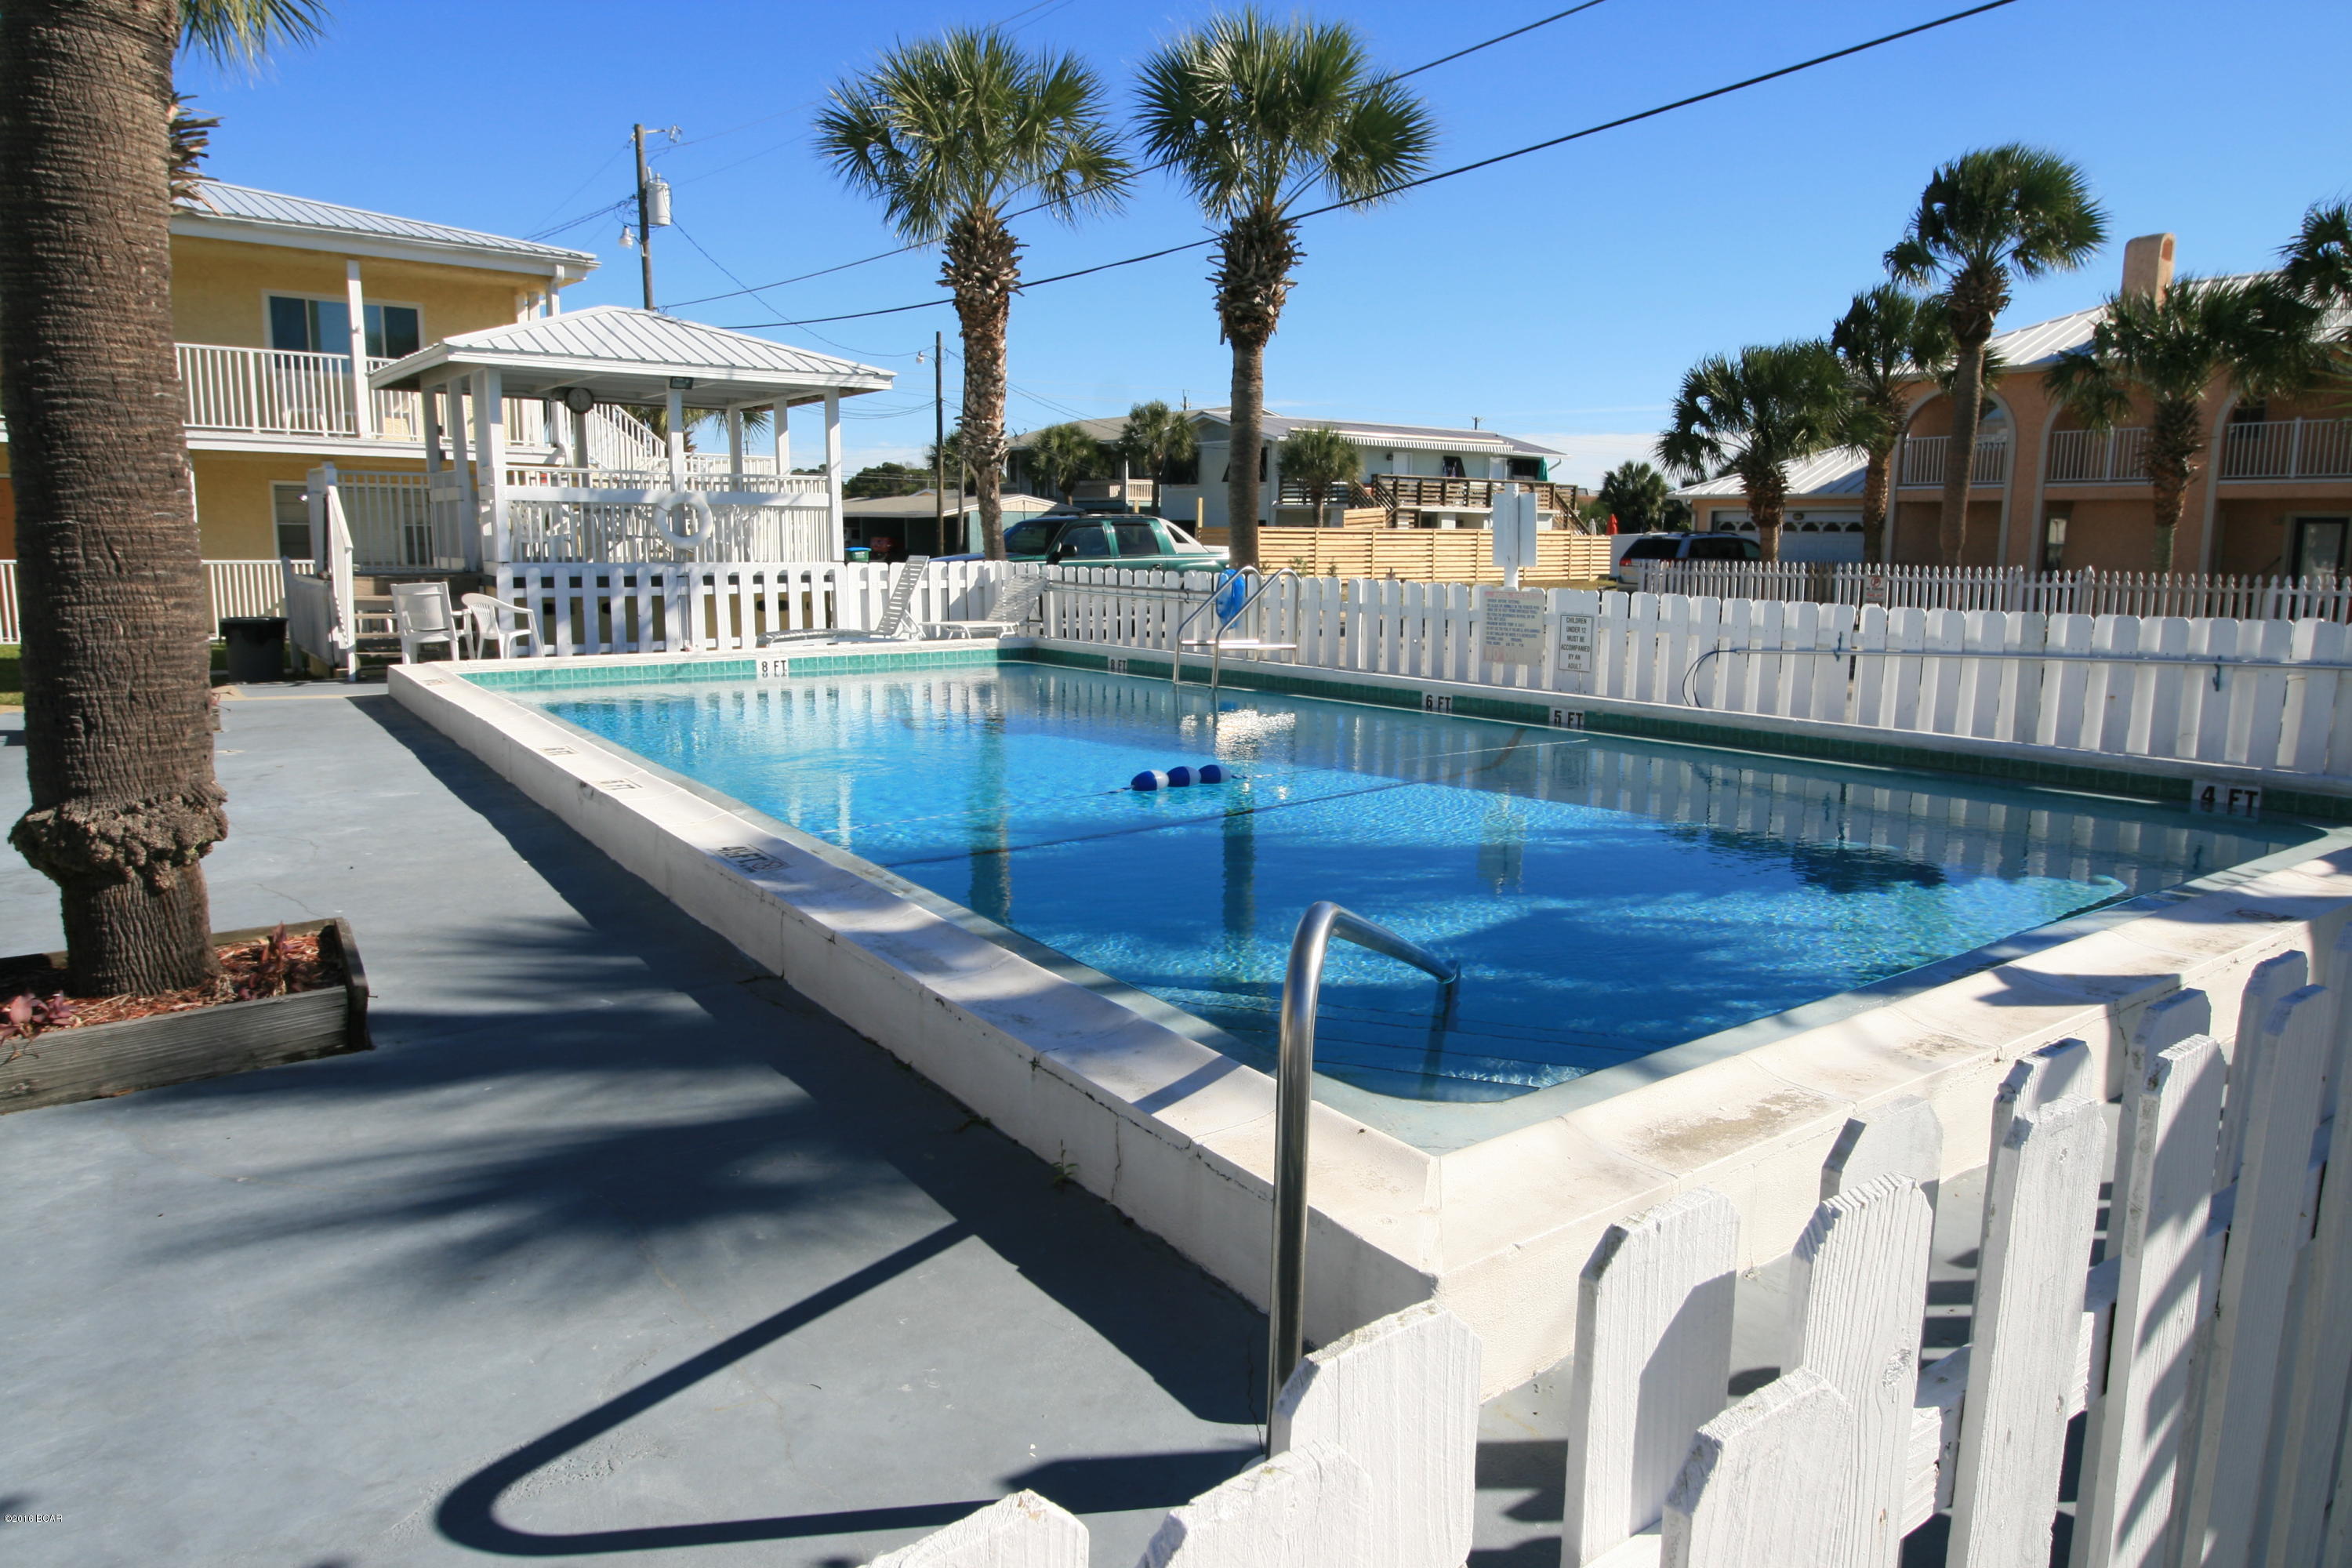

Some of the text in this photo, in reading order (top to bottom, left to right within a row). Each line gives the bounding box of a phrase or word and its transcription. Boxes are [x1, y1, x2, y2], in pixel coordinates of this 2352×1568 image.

[761, 661, 768, 672] 8
[1426, 695, 1433, 709] 6
[1554, 710, 1562, 724] 5
[2201, 786, 2258, 808] 4 FT
